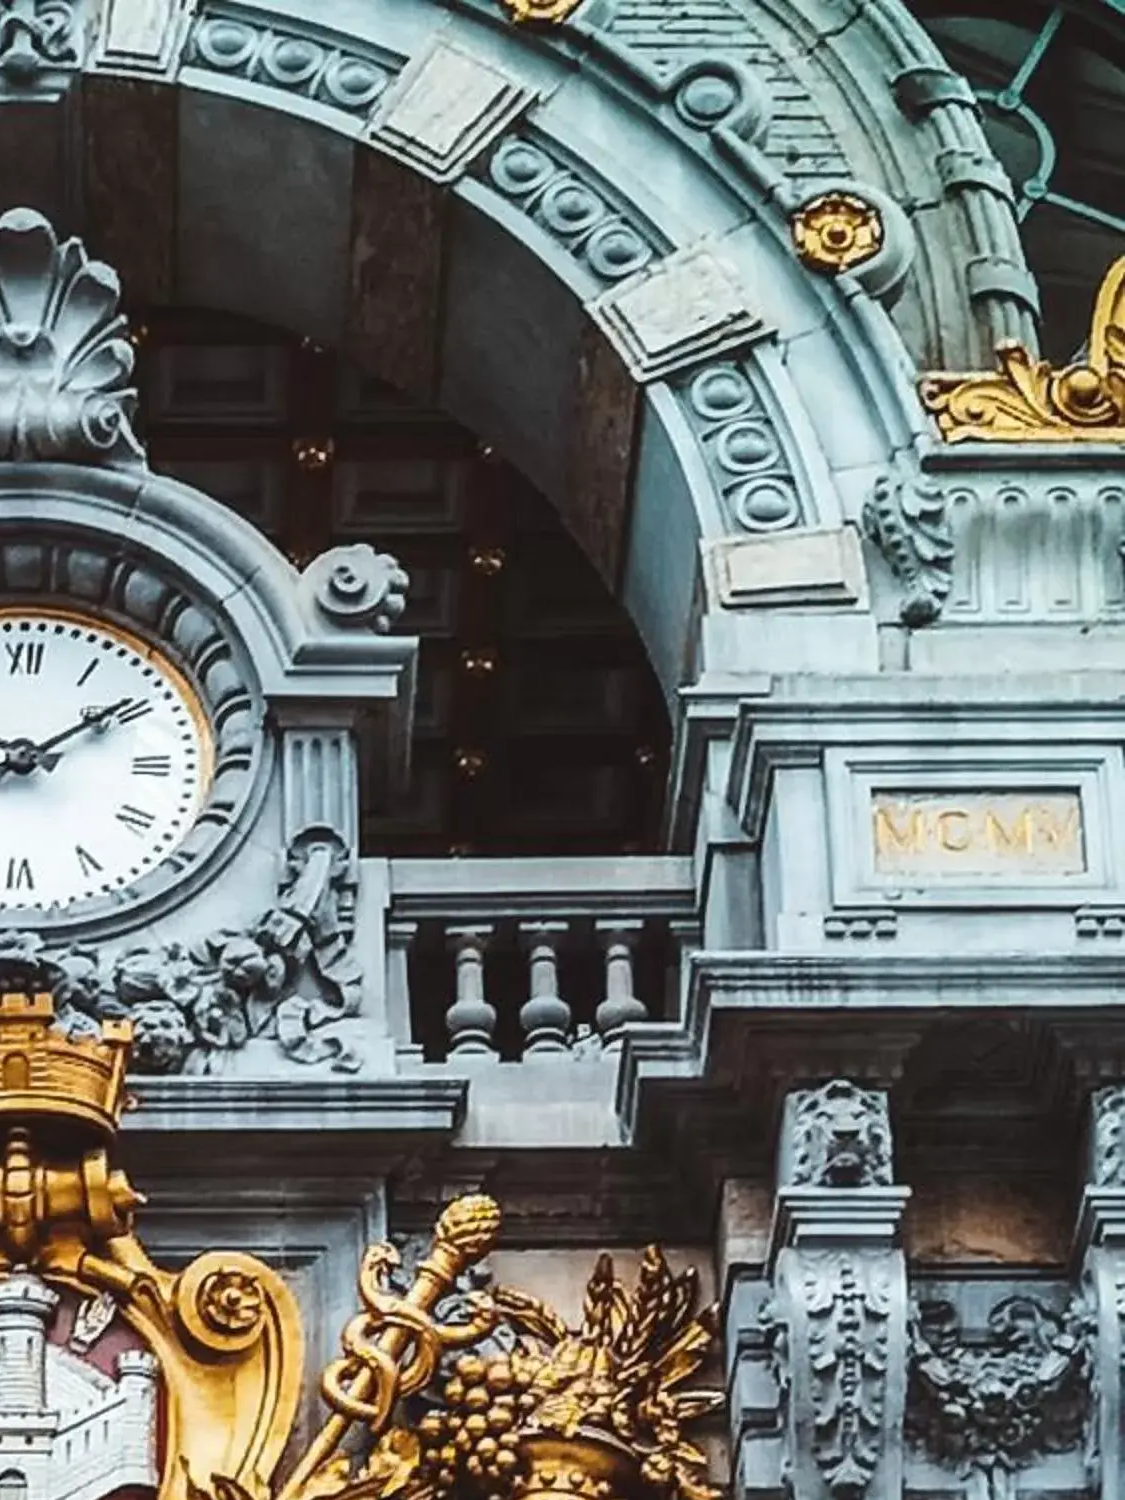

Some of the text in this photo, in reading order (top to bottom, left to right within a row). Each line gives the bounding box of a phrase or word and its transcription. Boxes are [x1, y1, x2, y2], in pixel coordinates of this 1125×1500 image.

[5, 641, 45, 675] XII
[131, 755, 171, 777] III
[6, 857, 35, 890] VI
[75, 846, 103, 877] V
